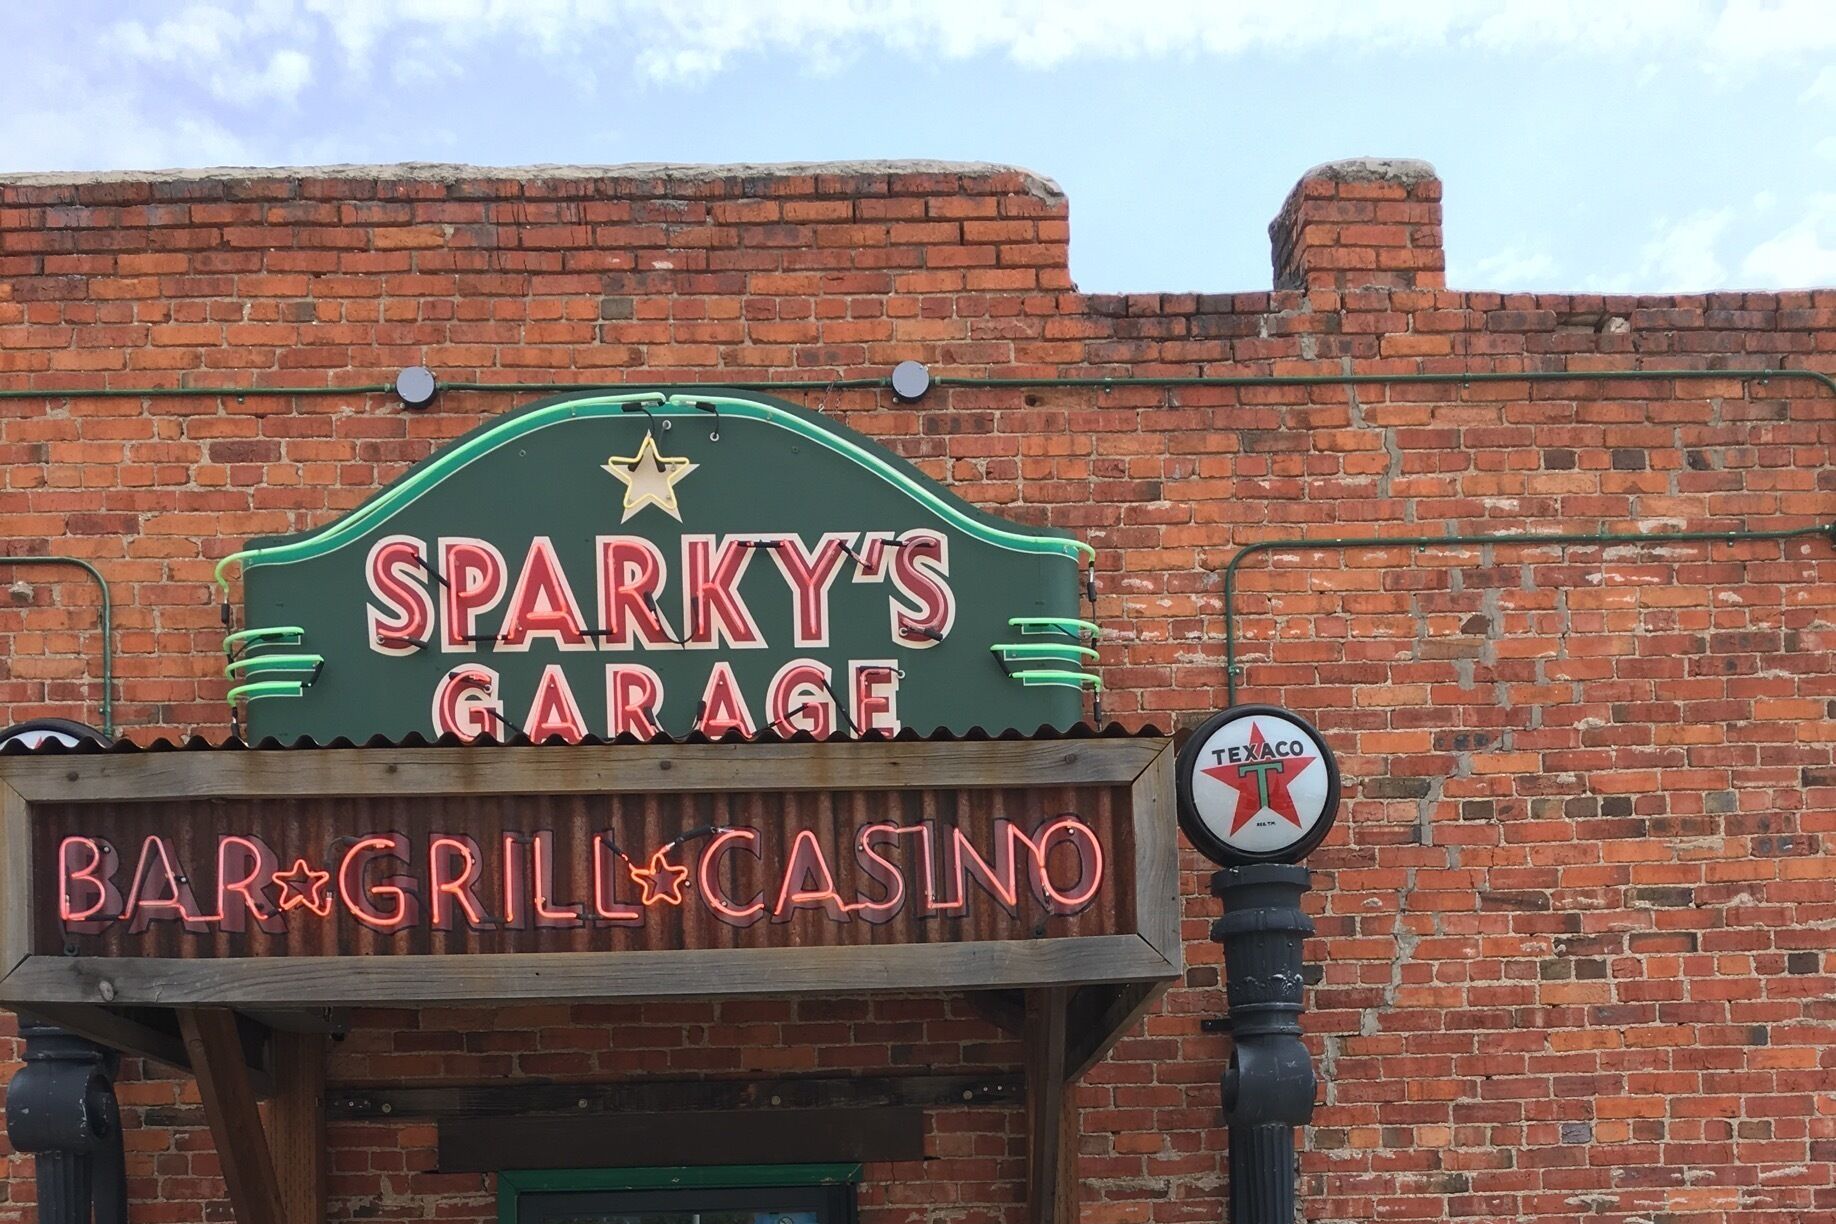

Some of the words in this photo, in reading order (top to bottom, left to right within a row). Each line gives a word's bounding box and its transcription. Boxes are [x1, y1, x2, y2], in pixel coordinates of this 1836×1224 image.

[366, 528, 957, 656] SPARKY'S
[432, 658, 902, 741] GARAGE
[1212, 740, 1304, 765] TEXACO
[58, 833, 288, 934] BAR
[339, 827, 645, 934] GRILL
[697, 813, 1105, 928] CASINO
